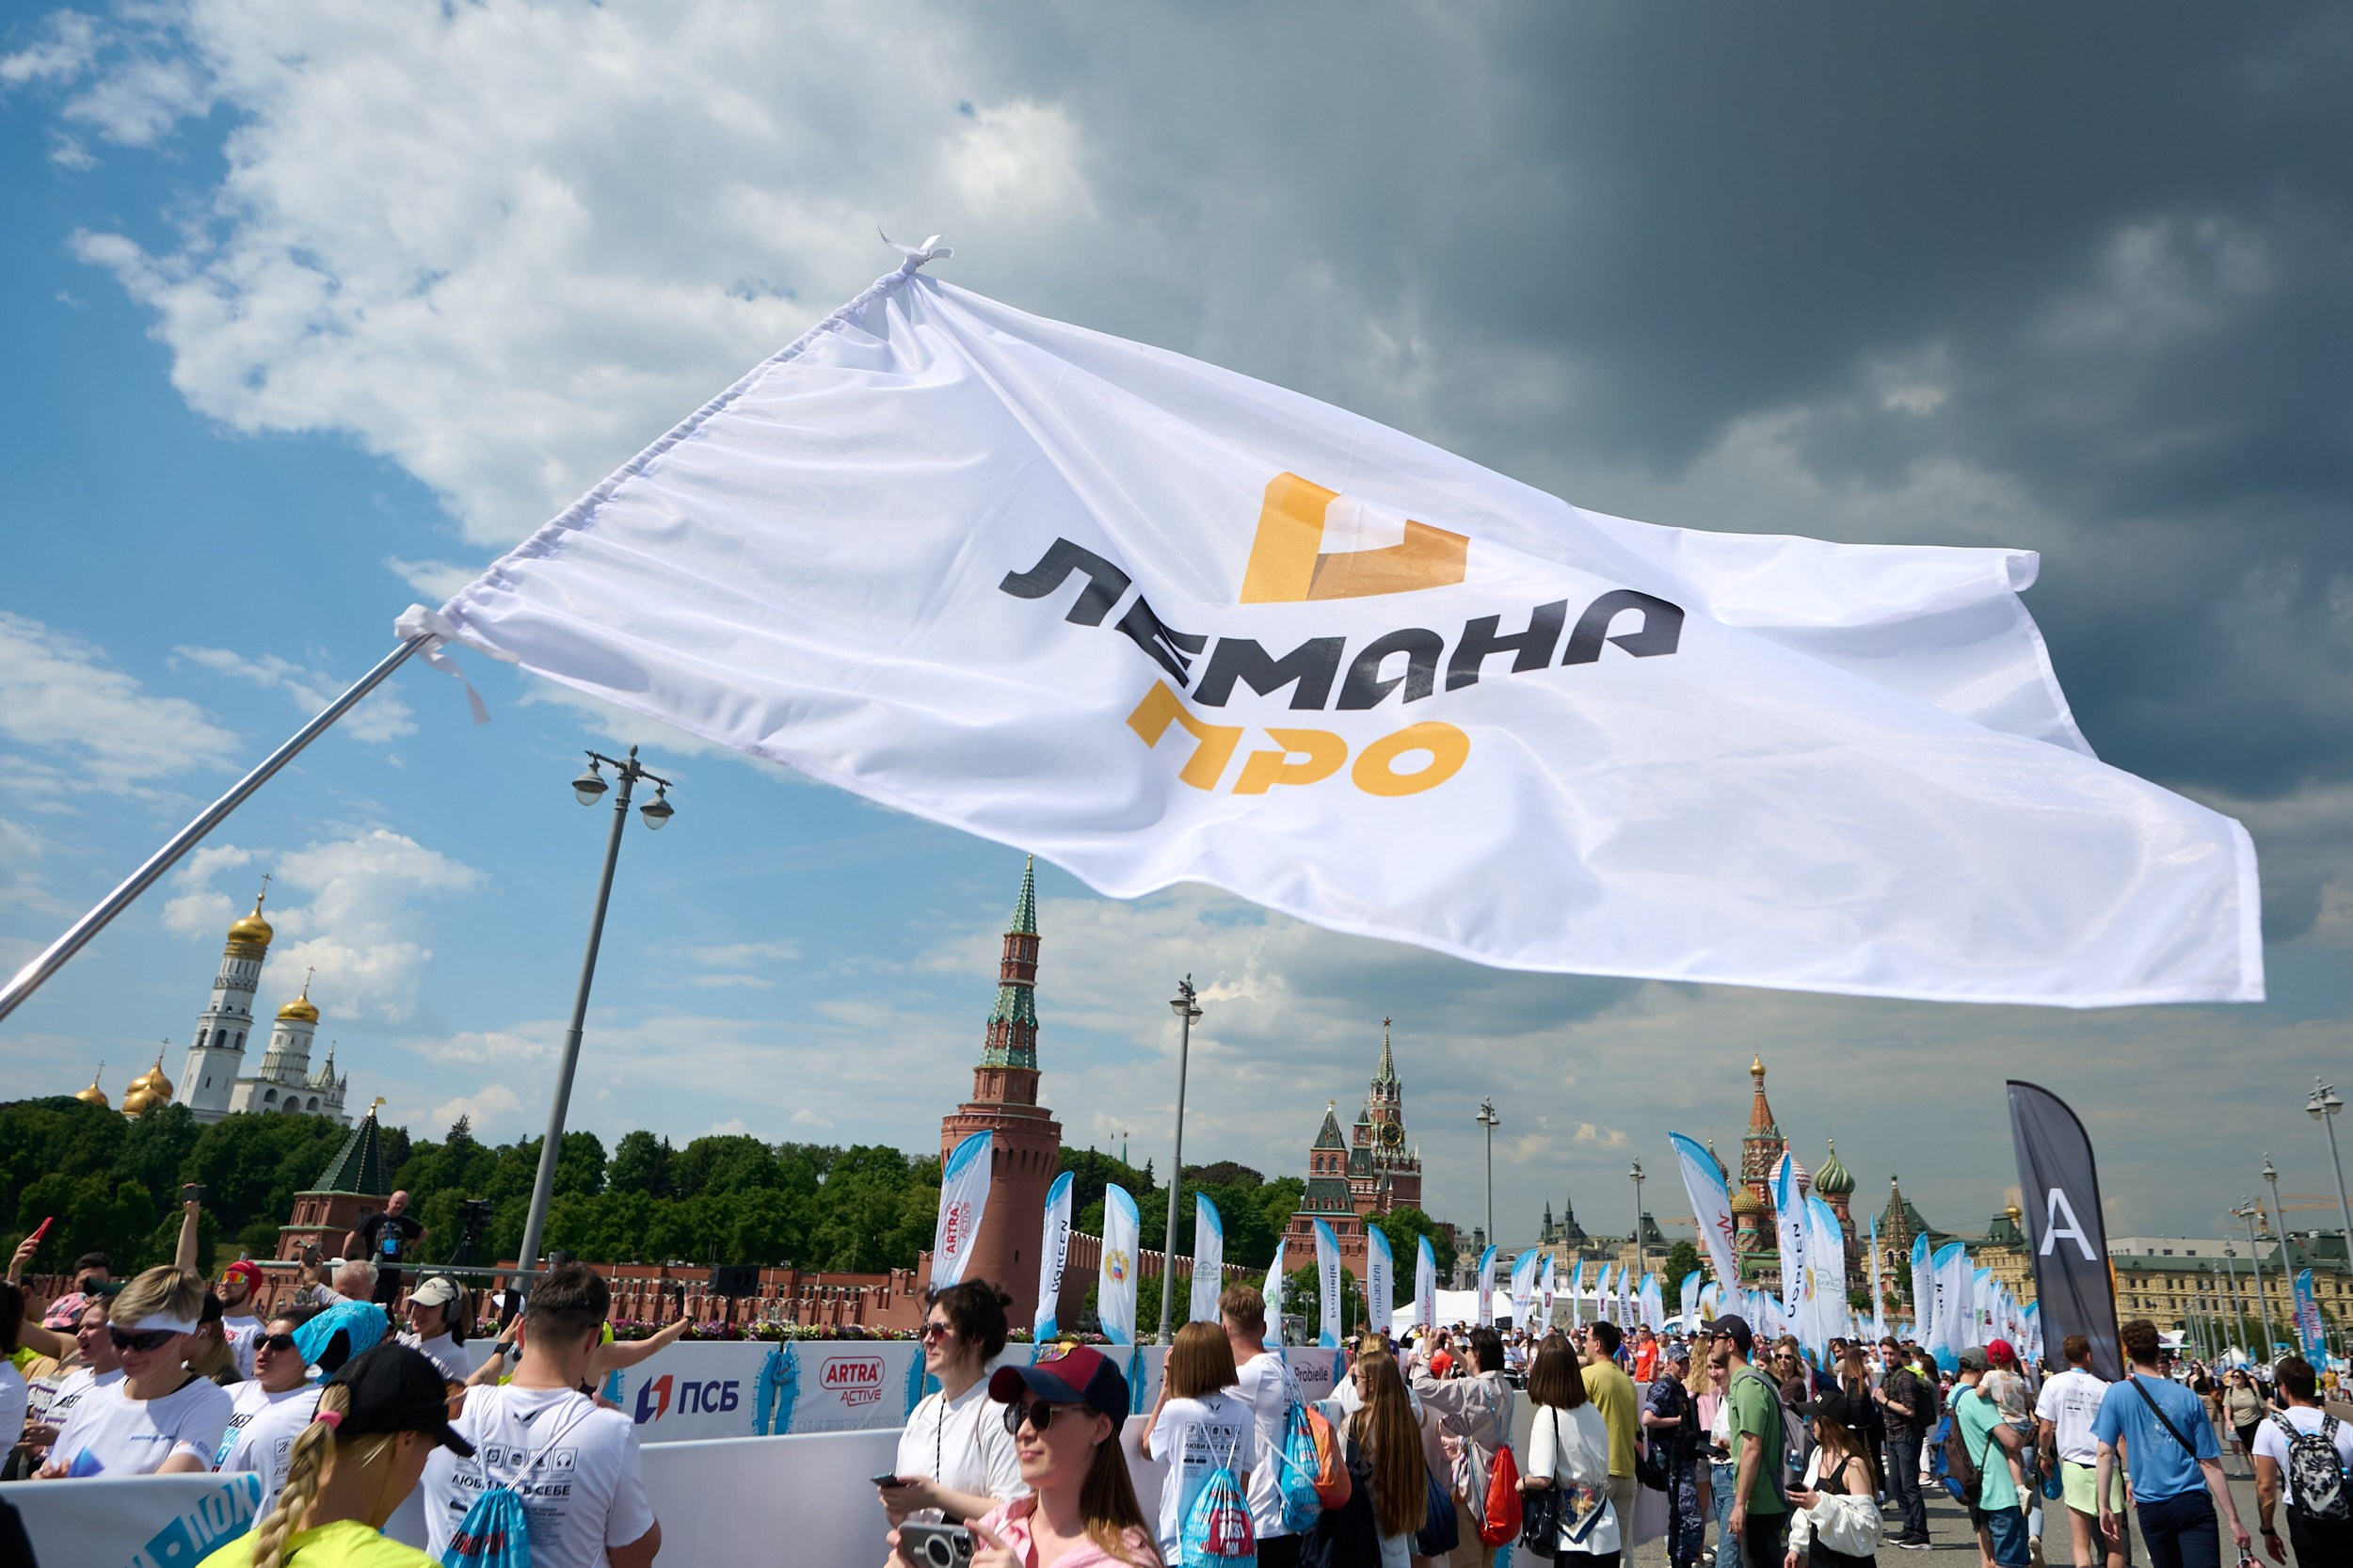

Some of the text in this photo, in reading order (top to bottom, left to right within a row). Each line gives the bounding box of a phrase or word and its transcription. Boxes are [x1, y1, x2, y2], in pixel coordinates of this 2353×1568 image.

[999, 536, 1685, 712] ЛЕМАНА
[1126, 678, 1471, 798] ПРО
[947, 1207, 959, 1254] ARTRA
[961, 1202, 970, 1240] ACTIVE
[1051, 1220, 1068, 1293] UGREEN
[825, 1363, 877, 1383] ARTRA
[1294, 1367, 1328, 1382] Probielle
[678, 1381, 740, 1414] ПСБ
[840, 1388, 882, 1404] ACTIVE
[535, 1484, 571, 1496] СЕБЕ
